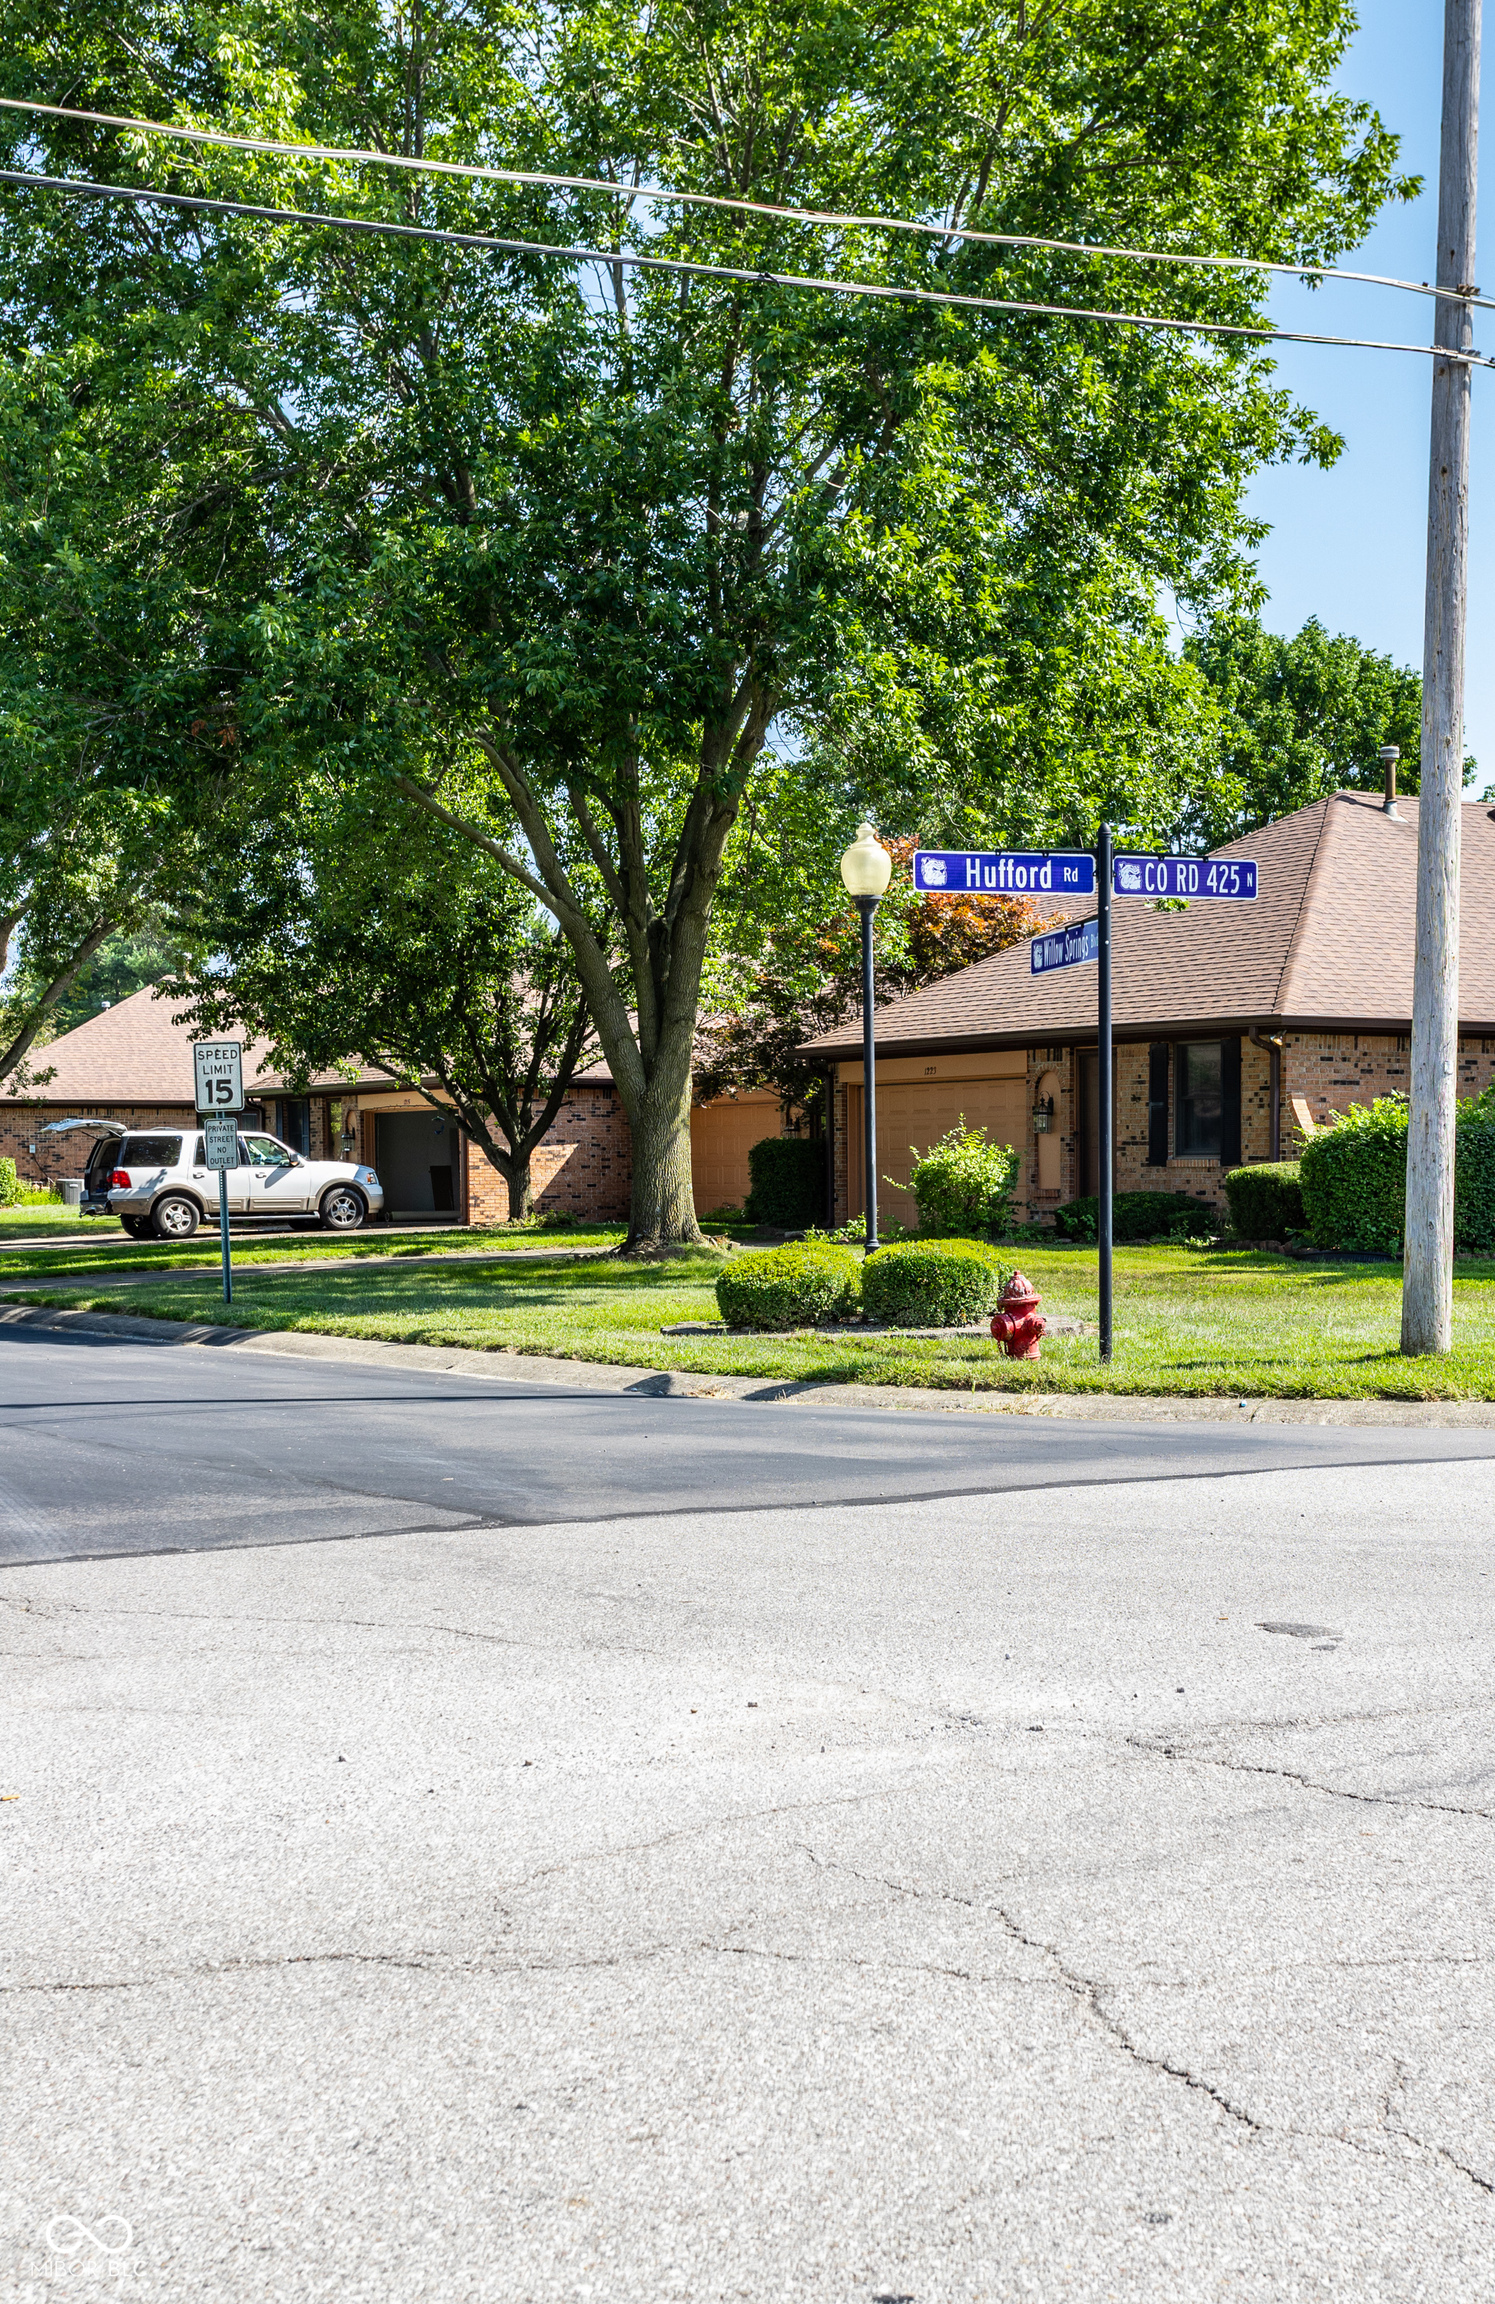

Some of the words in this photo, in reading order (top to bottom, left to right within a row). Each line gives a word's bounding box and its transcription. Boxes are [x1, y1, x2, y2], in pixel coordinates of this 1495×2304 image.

[966, 858, 1052, 889] Hufford
[1064, 868, 1079, 883] Rd
[1145, 862, 1167, 892] CO
[1177, 864, 1199, 893] RD
[1206, 865, 1239, 894] 425
[1247, 877, 1253, 888] N
[1044, 938, 1063, 967] Willow
[1065, 931, 1089, 962] Springs
[198, 1049, 237, 1060] SPEED
[203, 1064, 233, 1075] LIMIT
[205, 1079, 234, 1104] 15
[208, 1124, 235, 1132] PRIVATE
[210, 1157, 234, 1165] OUTLET
